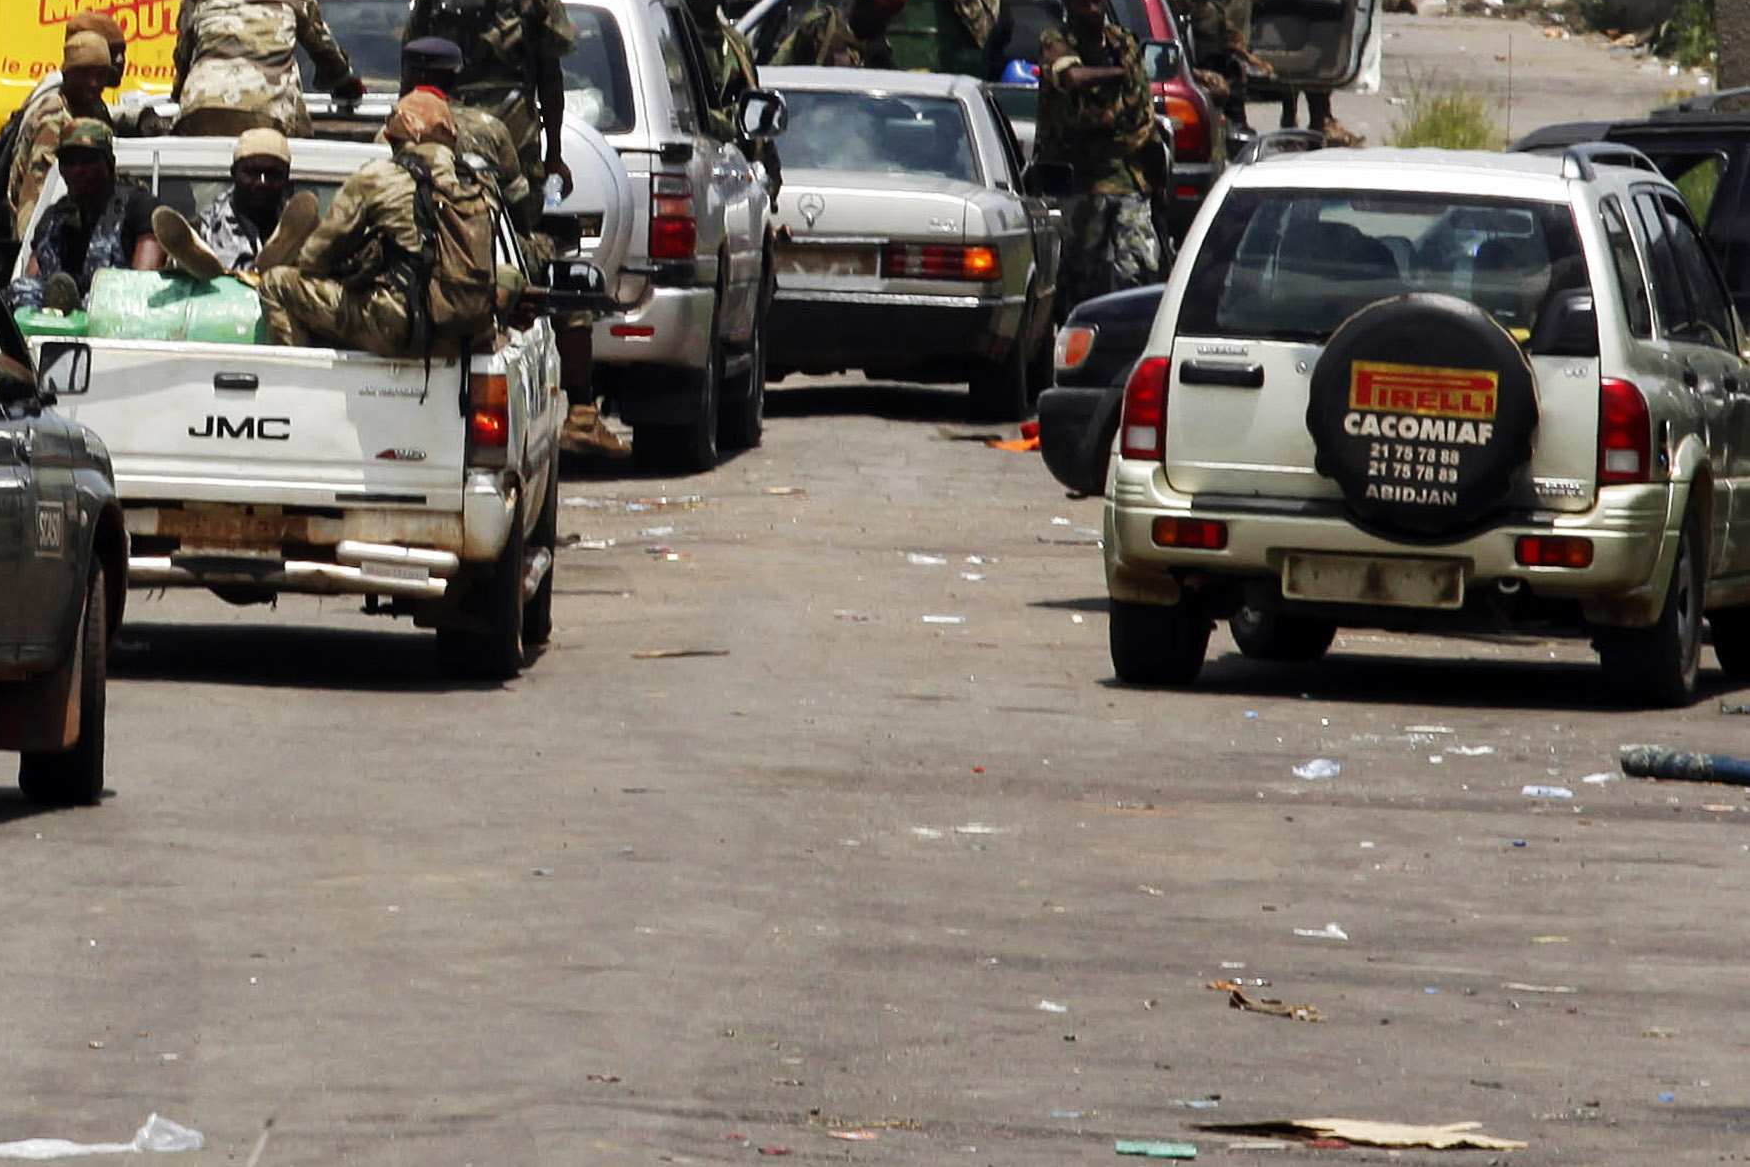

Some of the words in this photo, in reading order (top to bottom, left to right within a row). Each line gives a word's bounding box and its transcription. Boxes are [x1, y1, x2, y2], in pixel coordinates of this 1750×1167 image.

[2, 57, 20, 74] le
[1355, 370, 1496, 414] PIRELLI
[187, 416, 290, 440] JMC
[1344, 412, 1493, 446] CACOMIAF
[1370, 442, 1389, 458] 21
[1368, 460, 1387, 476] 21
[1365, 483, 1458, 506] ABIDJAN
